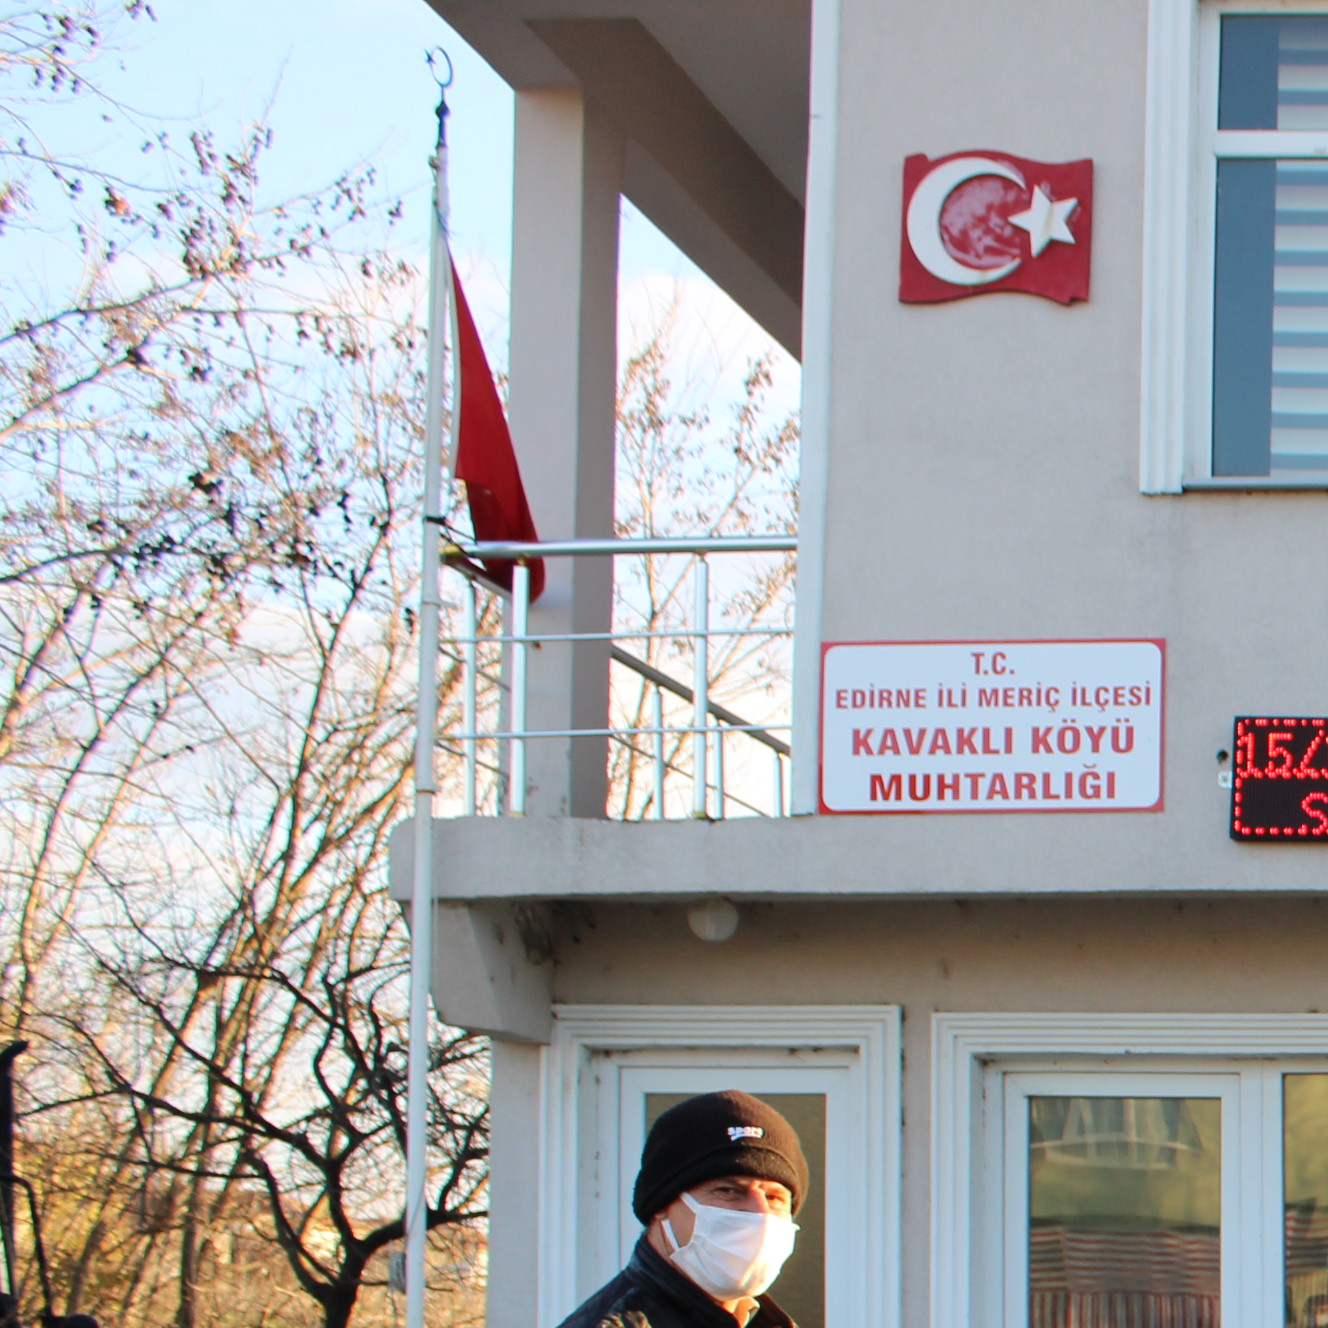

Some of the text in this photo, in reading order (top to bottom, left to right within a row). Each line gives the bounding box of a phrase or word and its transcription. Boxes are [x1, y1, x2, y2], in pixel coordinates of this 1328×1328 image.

[971, 652, 1016, 675] T.C.
[836, 681, 1152, 713] EDİRNE İLİ MERİÇ İLÇESİ
[852, 718, 1136, 756] KAVAKLI KÖYÜ
[870, 763, 1116, 801] MUHTARLIĞI
